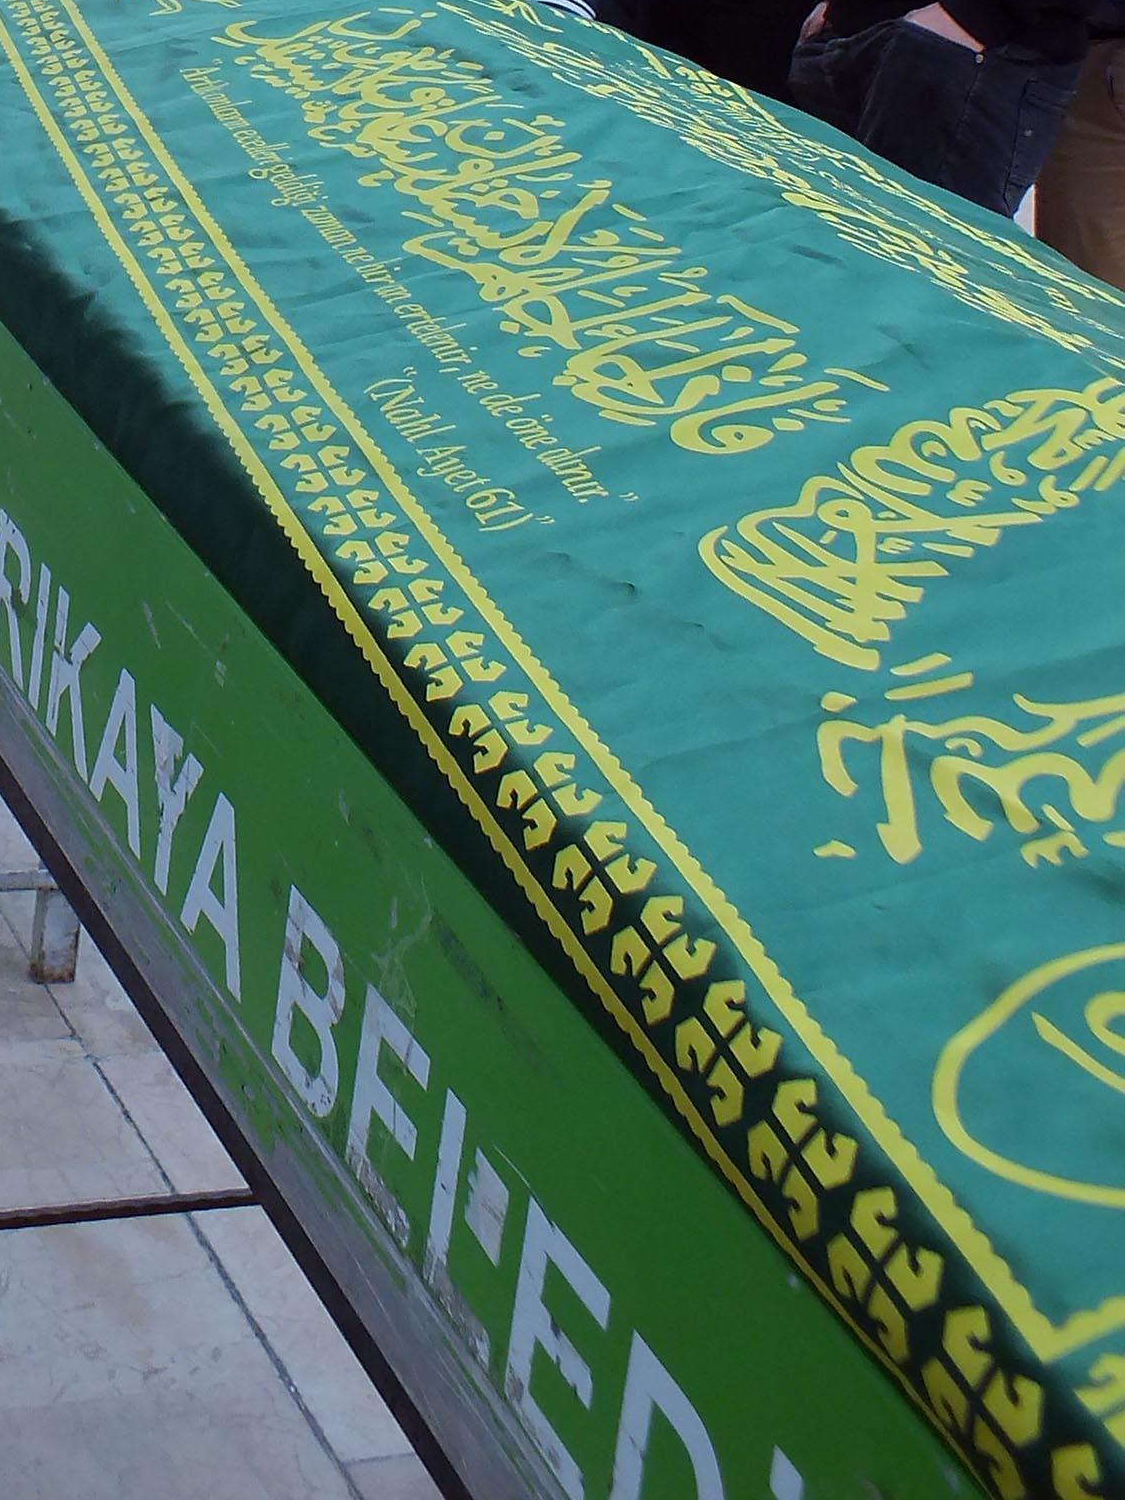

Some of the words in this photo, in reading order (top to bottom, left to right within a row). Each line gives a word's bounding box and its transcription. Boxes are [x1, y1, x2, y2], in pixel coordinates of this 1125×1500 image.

[457, 370, 498, 395] ne
[479, 393, 542, 418] de
[505, 413, 558, 450] öne
[416, 445, 491, 493] Ayet
